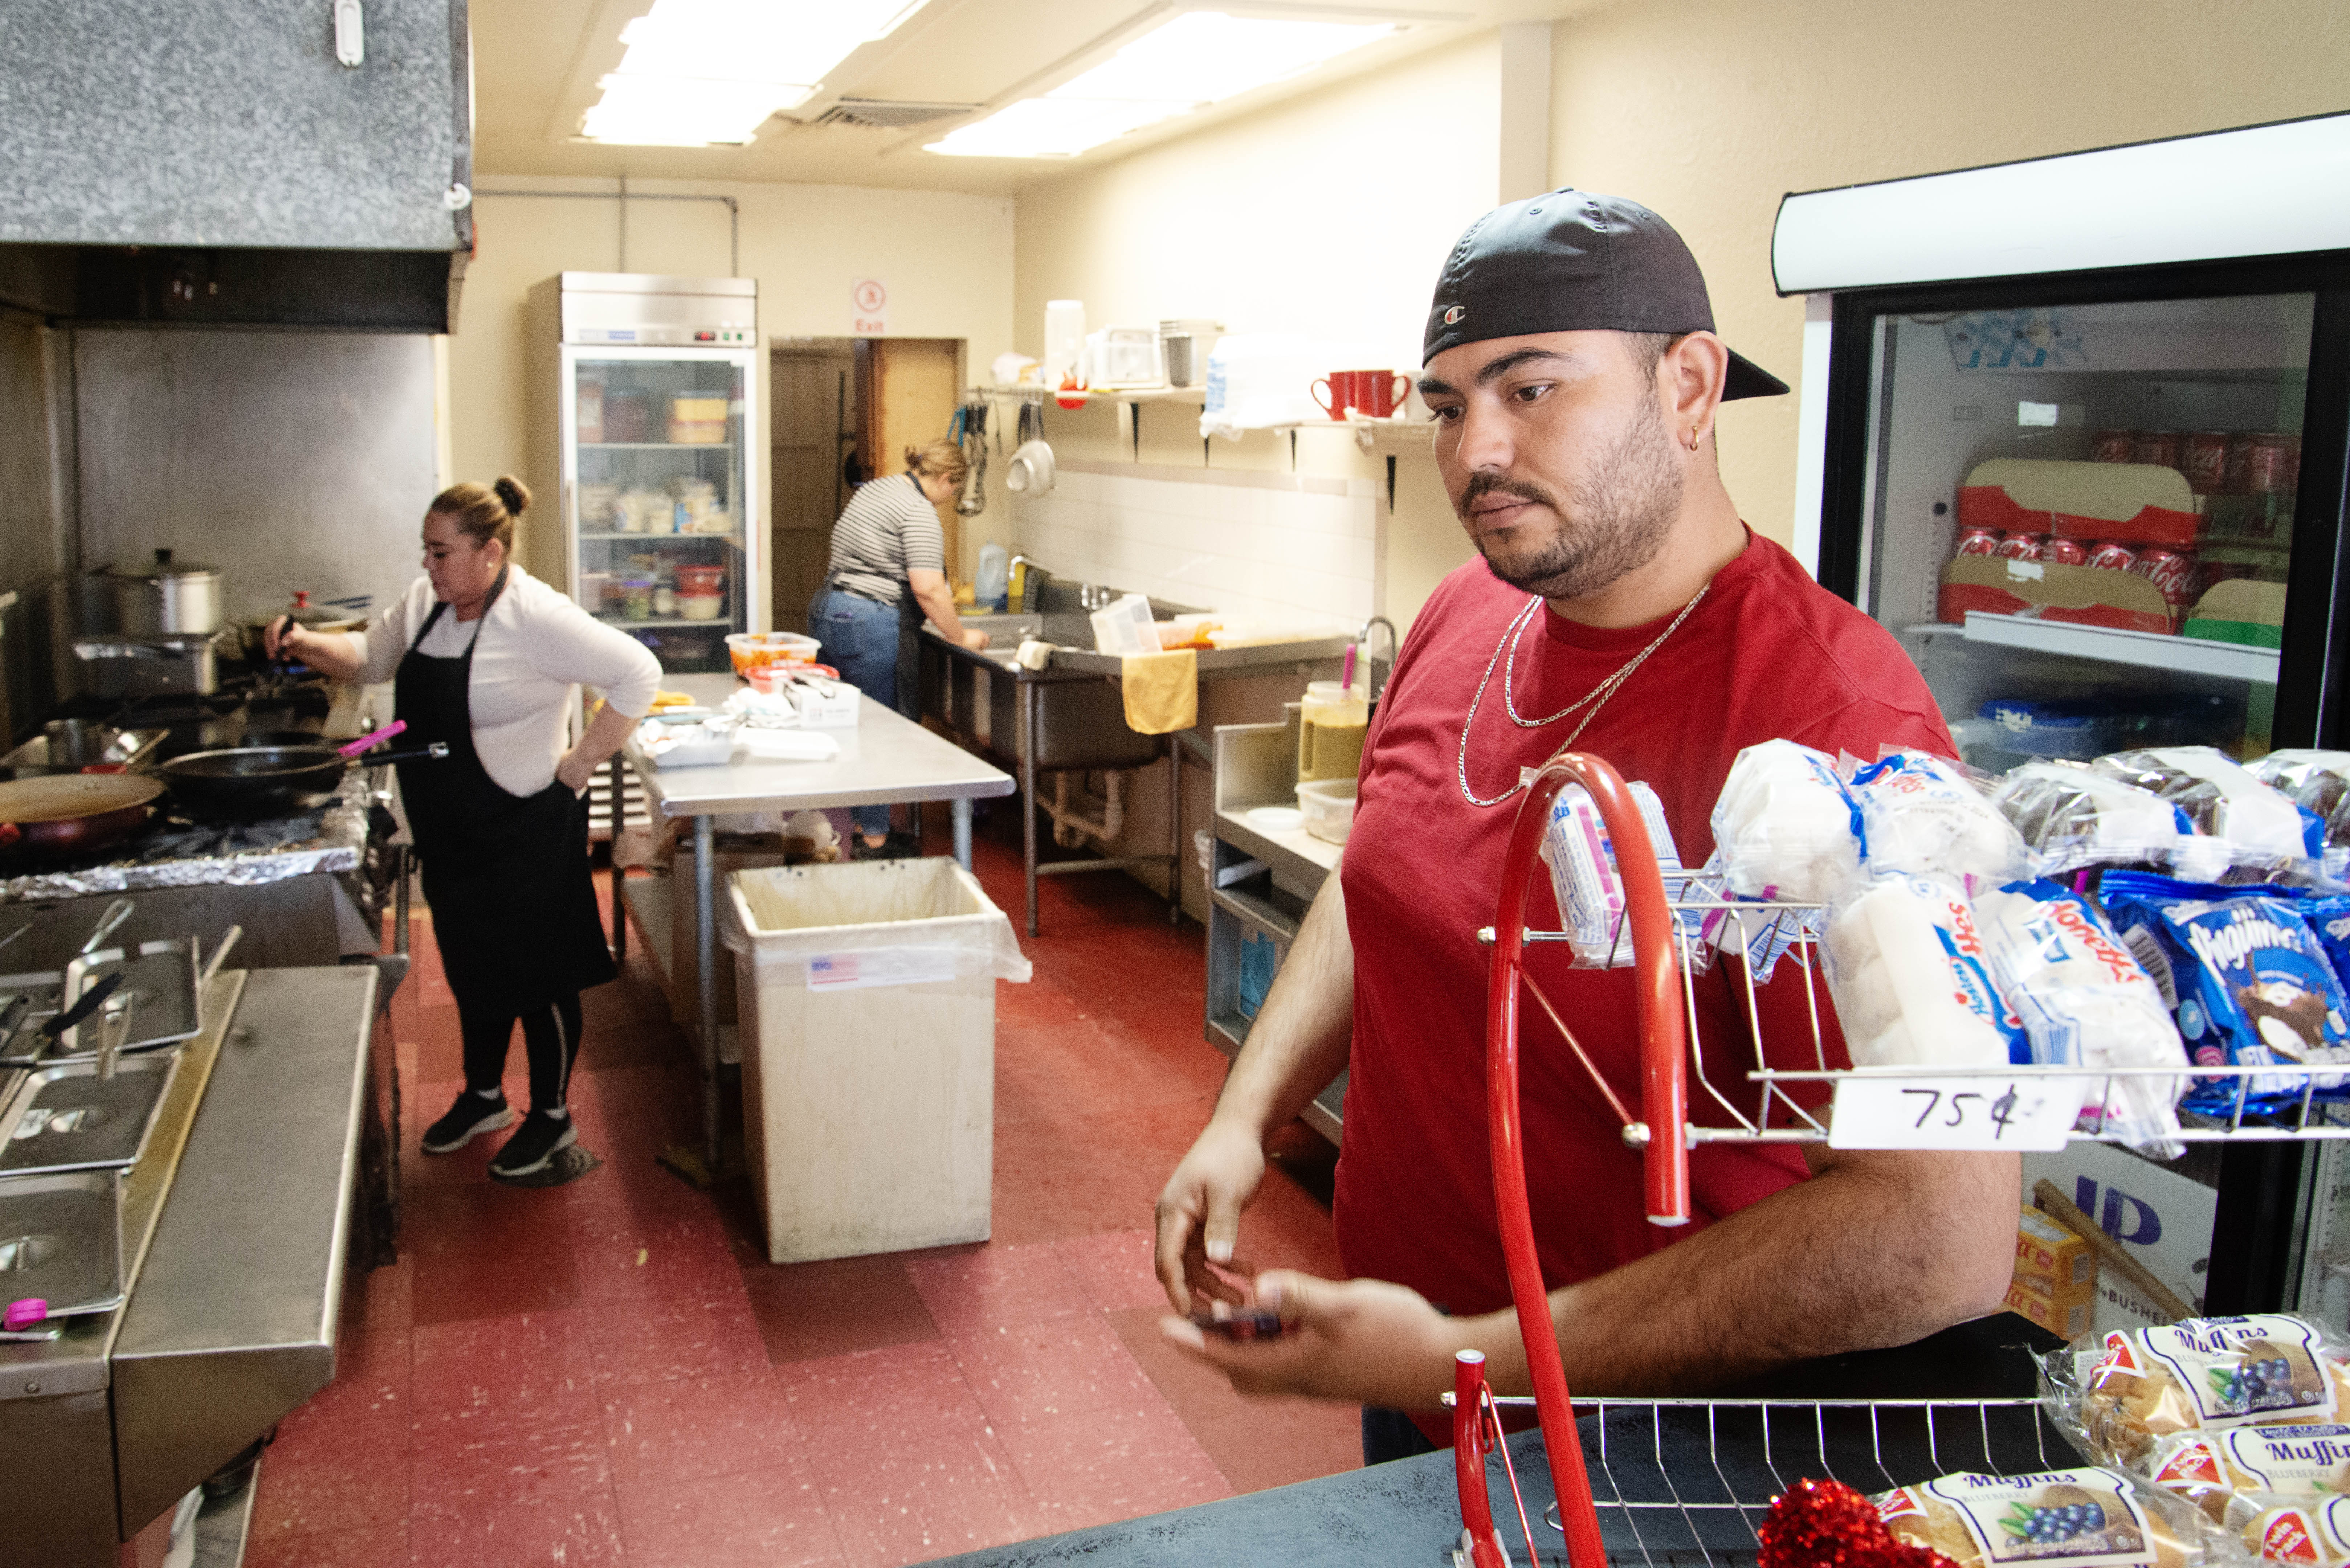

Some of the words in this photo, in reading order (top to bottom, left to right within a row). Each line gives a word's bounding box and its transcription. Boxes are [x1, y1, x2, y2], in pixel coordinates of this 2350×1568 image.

[855, 318, 884, 333] Exit
[1952, 963, 1991, 1015] Hostess
[2174, 1326, 2268, 1356] Muffns
[2265, 1522, 2295, 1552] Twin
